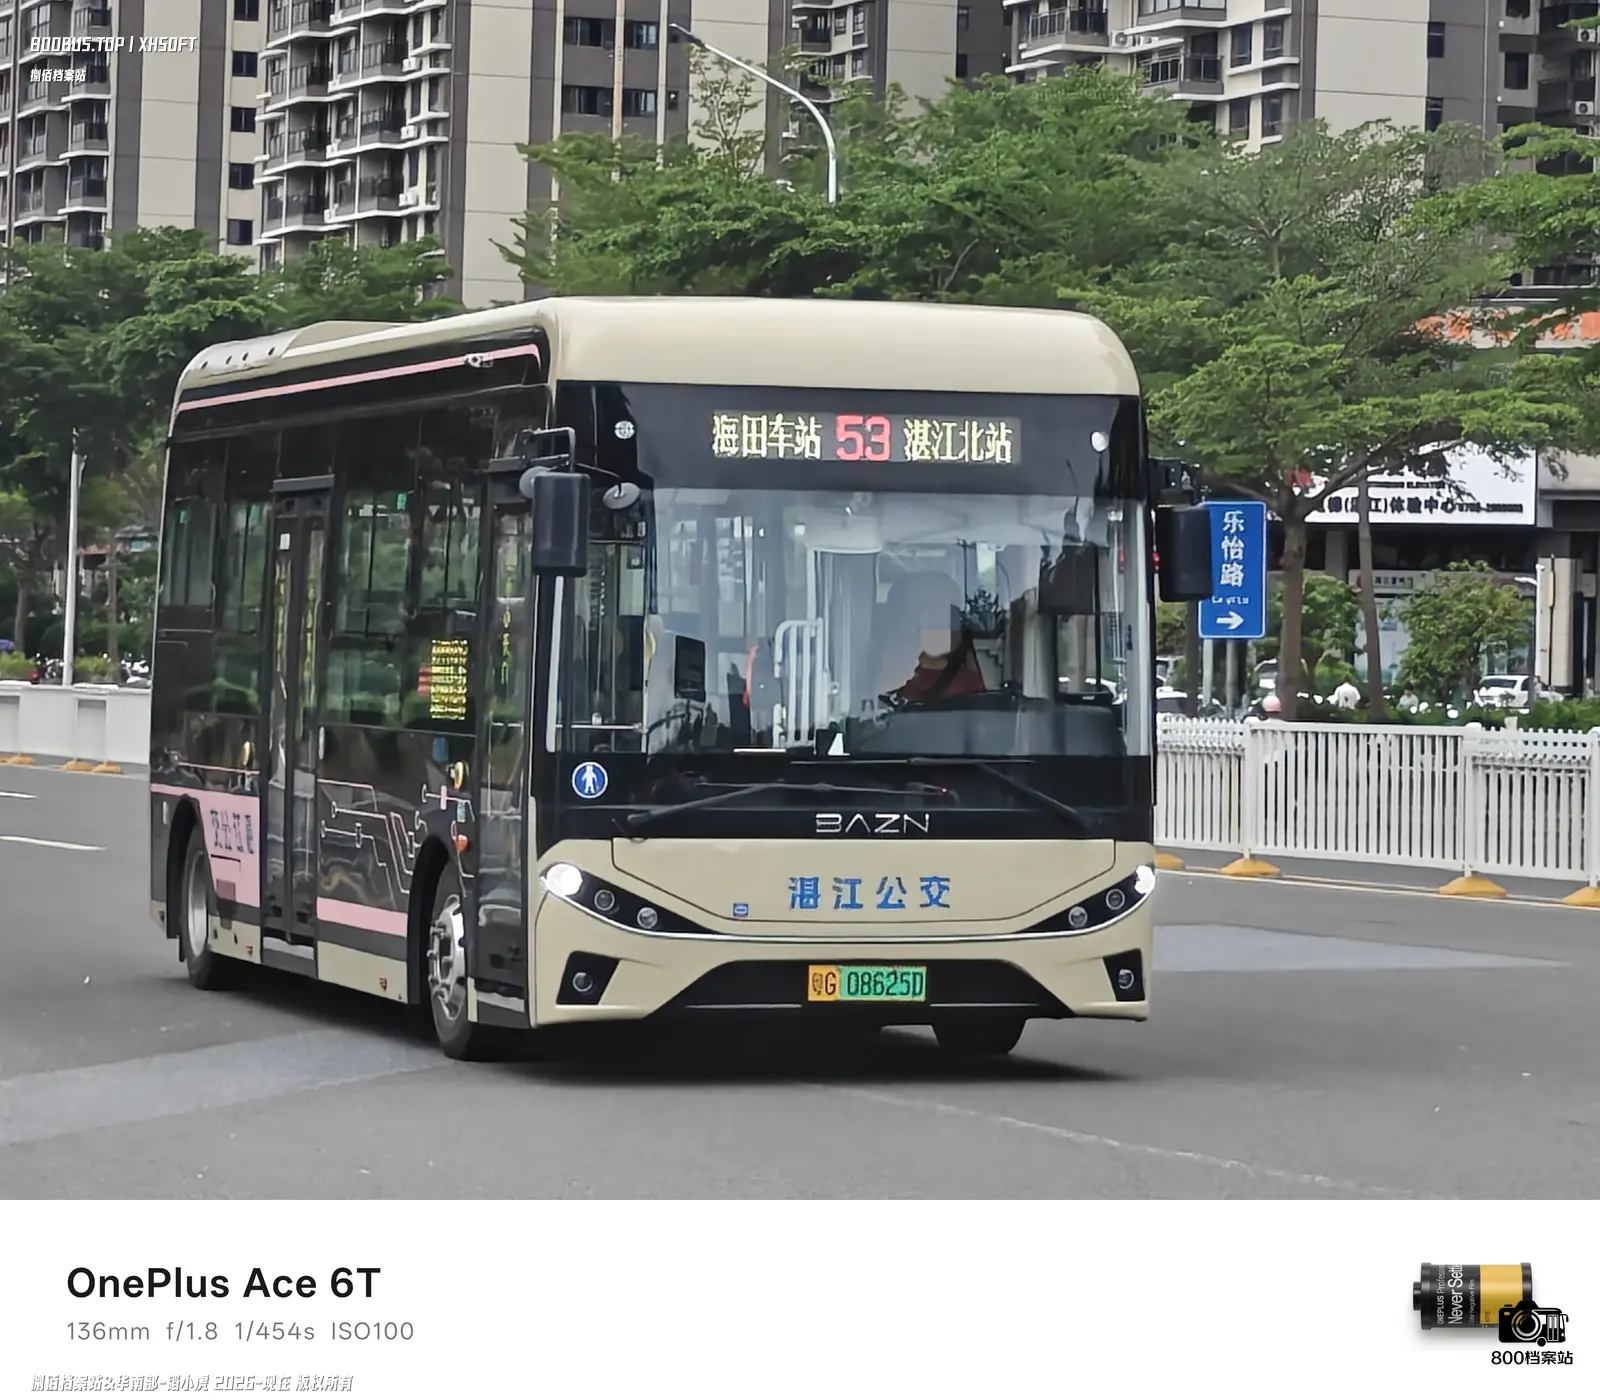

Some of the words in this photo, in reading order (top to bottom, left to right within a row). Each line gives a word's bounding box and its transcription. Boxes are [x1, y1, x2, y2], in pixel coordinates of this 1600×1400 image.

[711, 413, 823, 460] 海田车站
[835, 414, 891, 462] 53
[903, 417, 1013, 464] 湛江北站
[1220, 510, 1245, 587] 乐怡路
[815, 813, 930, 833] BAZN
[788, 876, 951, 910] 湛江公交
